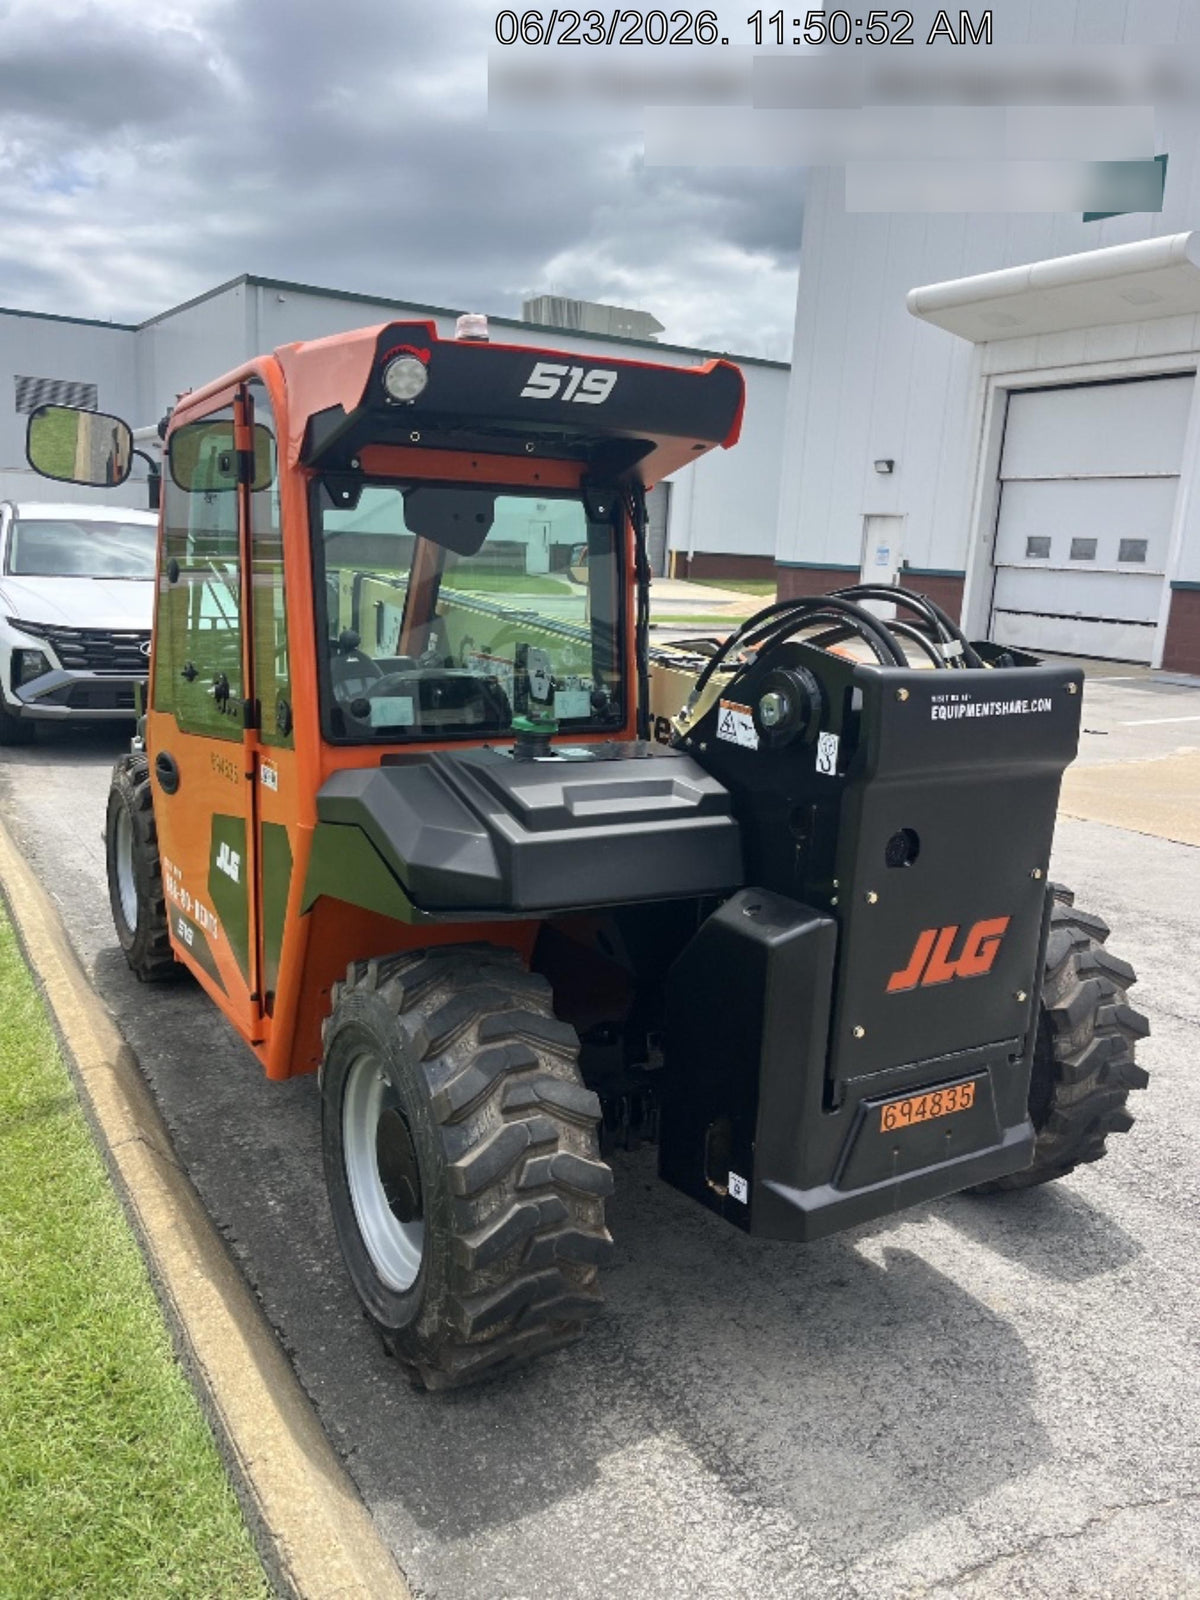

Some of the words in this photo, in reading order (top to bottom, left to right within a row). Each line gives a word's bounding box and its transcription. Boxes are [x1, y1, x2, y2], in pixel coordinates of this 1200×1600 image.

[520, 362, 618, 405] 519
[931, 698, 1052, 721] EQUIPMENTSHARE.COM
[216, 842, 240, 883] JLG
[885, 916, 1012, 994] JLG
[883, 1084, 972, 1129] 694835
